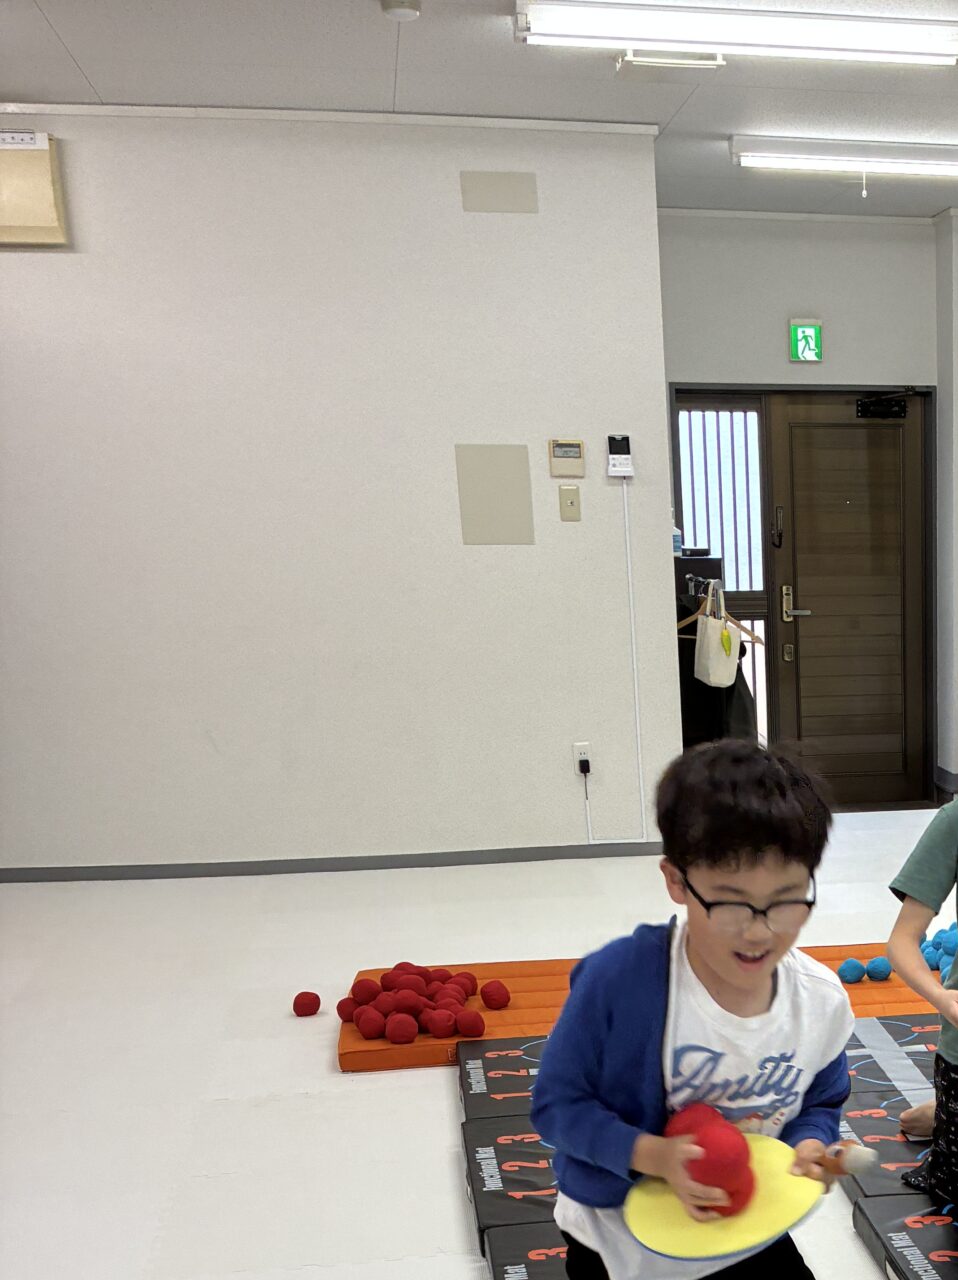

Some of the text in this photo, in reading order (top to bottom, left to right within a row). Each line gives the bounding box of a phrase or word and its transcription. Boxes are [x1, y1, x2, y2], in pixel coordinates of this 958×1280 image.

[488, 1069, 528, 1077] 2
[468, 1067, 487, 1093] Functional
[846, 1109, 888, 1118] 3
[496, 1133, 542, 1144] 3
[475, 1146, 504, 1191] Functional Mat
[501, 1160, 549, 1171] 2
[507, 1188, 557, 1200] 1
[904, 1216, 953, 1229] 3
[887, 1232, 915, 1248] Mat
[527, 1246, 569, 1260] 3
[504, 1264, 529, 1280] Mat
